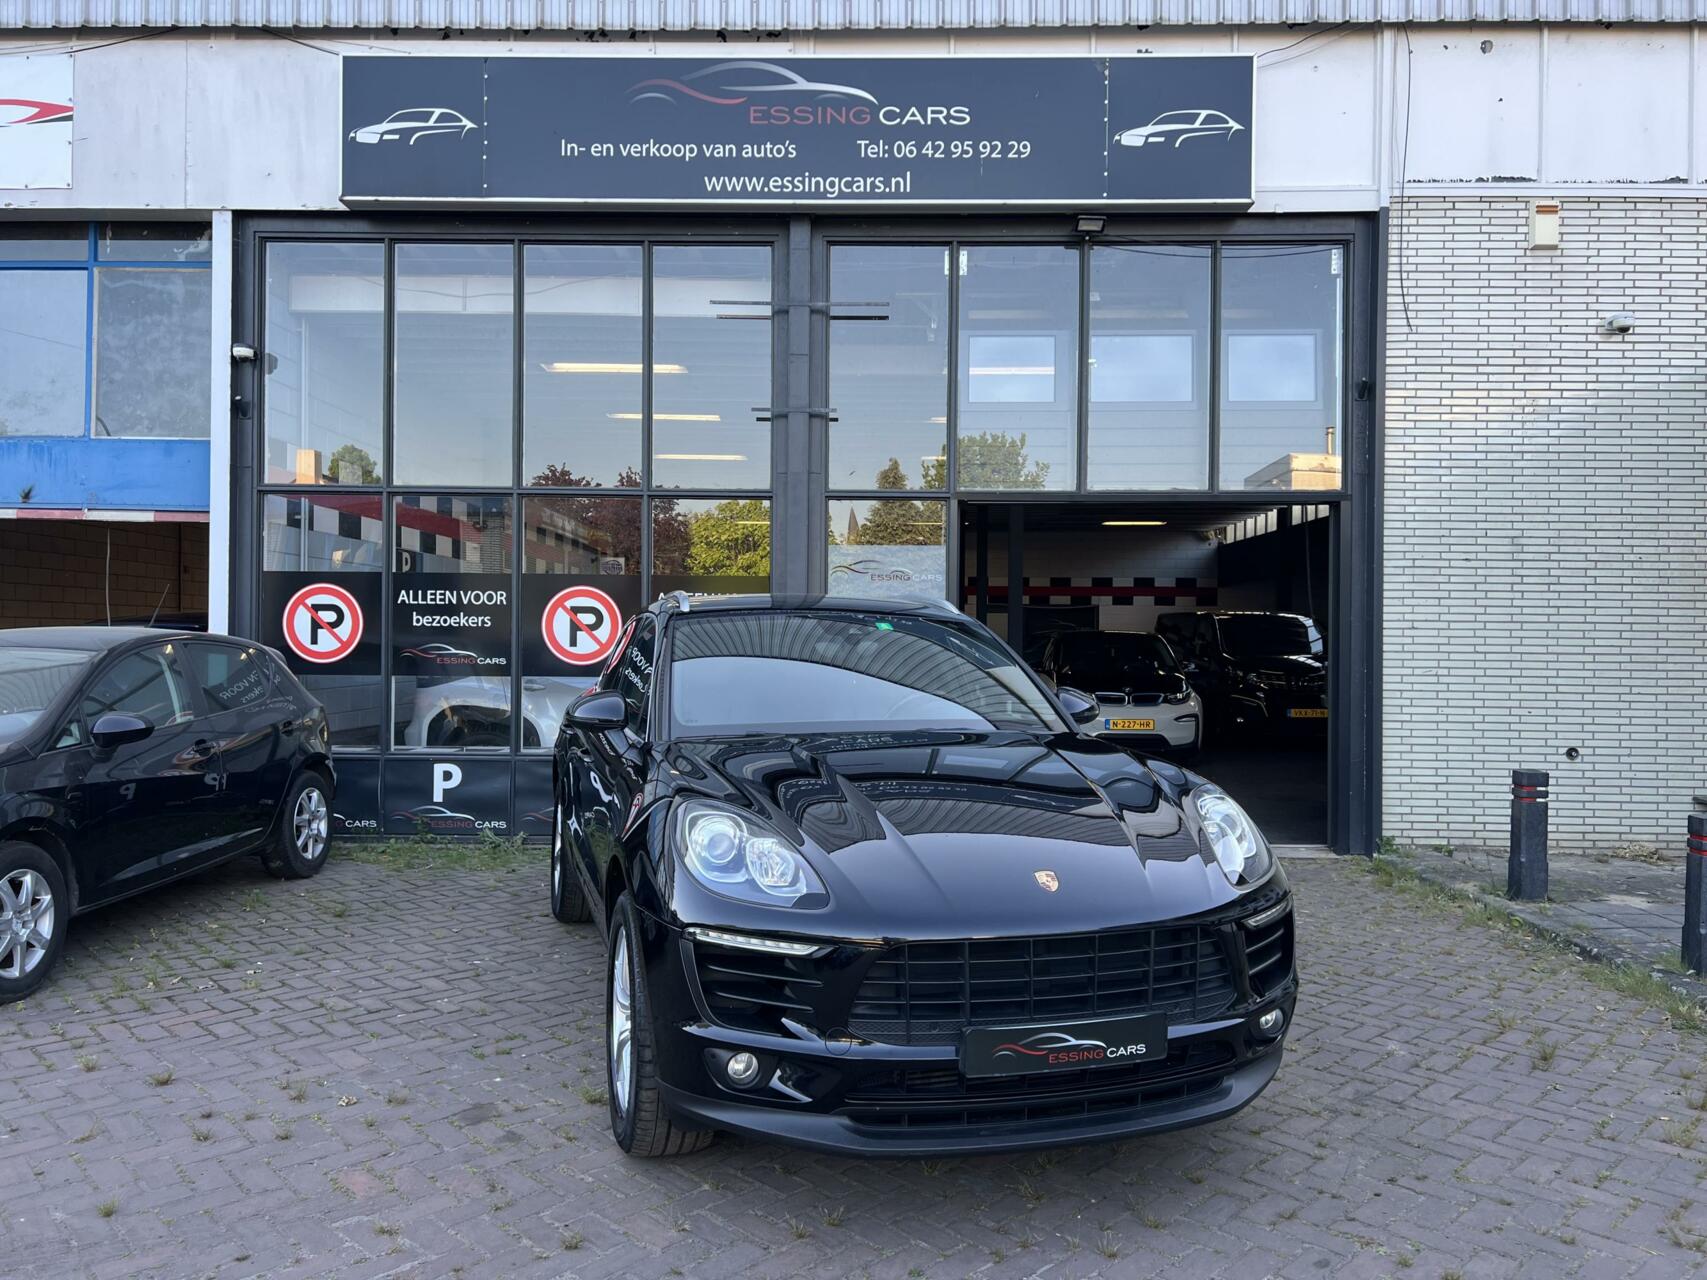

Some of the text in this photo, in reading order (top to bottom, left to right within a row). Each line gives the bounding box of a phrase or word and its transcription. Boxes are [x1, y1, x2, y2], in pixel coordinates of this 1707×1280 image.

[749, 105, 971, 126] ESSING CARS
[560, 138, 586, 157] In-
[590, 142, 614, 157] en
[619, 138, 698, 161] verkoop
[702, 142, 737, 158] van
[856, 139, 1032, 159] Tel: 06 42 95 92 29
[703, 171, 911, 198] www.essingcars.nl
[870, 573, 943, 582] ESSING CARS
[397, 589, 507, 606] ALLEEN VOOR
[412, 611, 492, 628] bezoekers
[436, 656, 507, 666] ESSING CARS
[1112, 721, 1151, 729] N-227-HR
[432, 763, 463, 803] P
[345, 819, 377, 828] CARS
[431, 820, 507, 829] ESSING CARS
[1049, 1044, 1147, 1063] ESSING CARS
